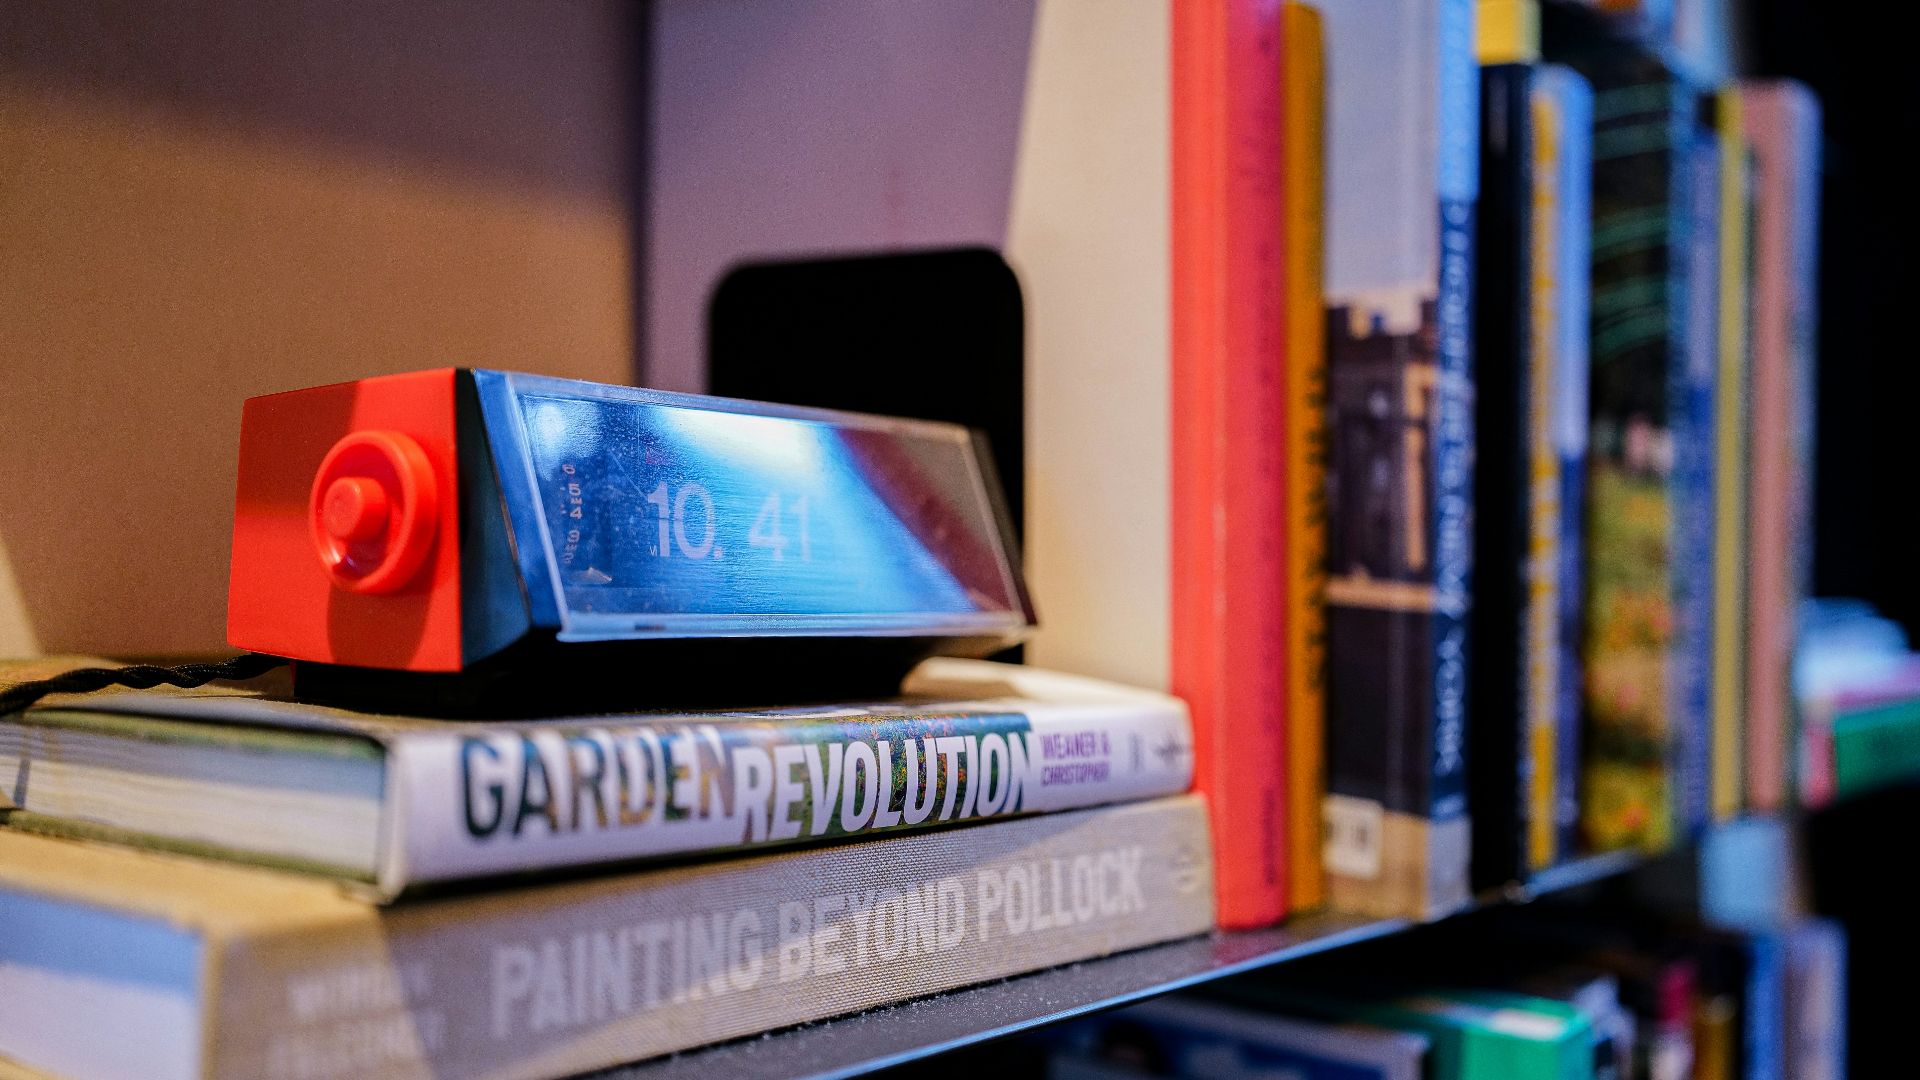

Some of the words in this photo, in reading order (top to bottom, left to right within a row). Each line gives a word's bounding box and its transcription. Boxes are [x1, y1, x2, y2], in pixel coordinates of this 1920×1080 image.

[748, 491, 813, 562] 41
[459, 735, 735, 837] GARDEN
[728, 731, 1034, 846] REVOLUTION
[490, 908, 765, 1040] PAINTING
[777, 876, 967, 982] BEYOND
[976, 844, 1147, 943] POLLOCK
